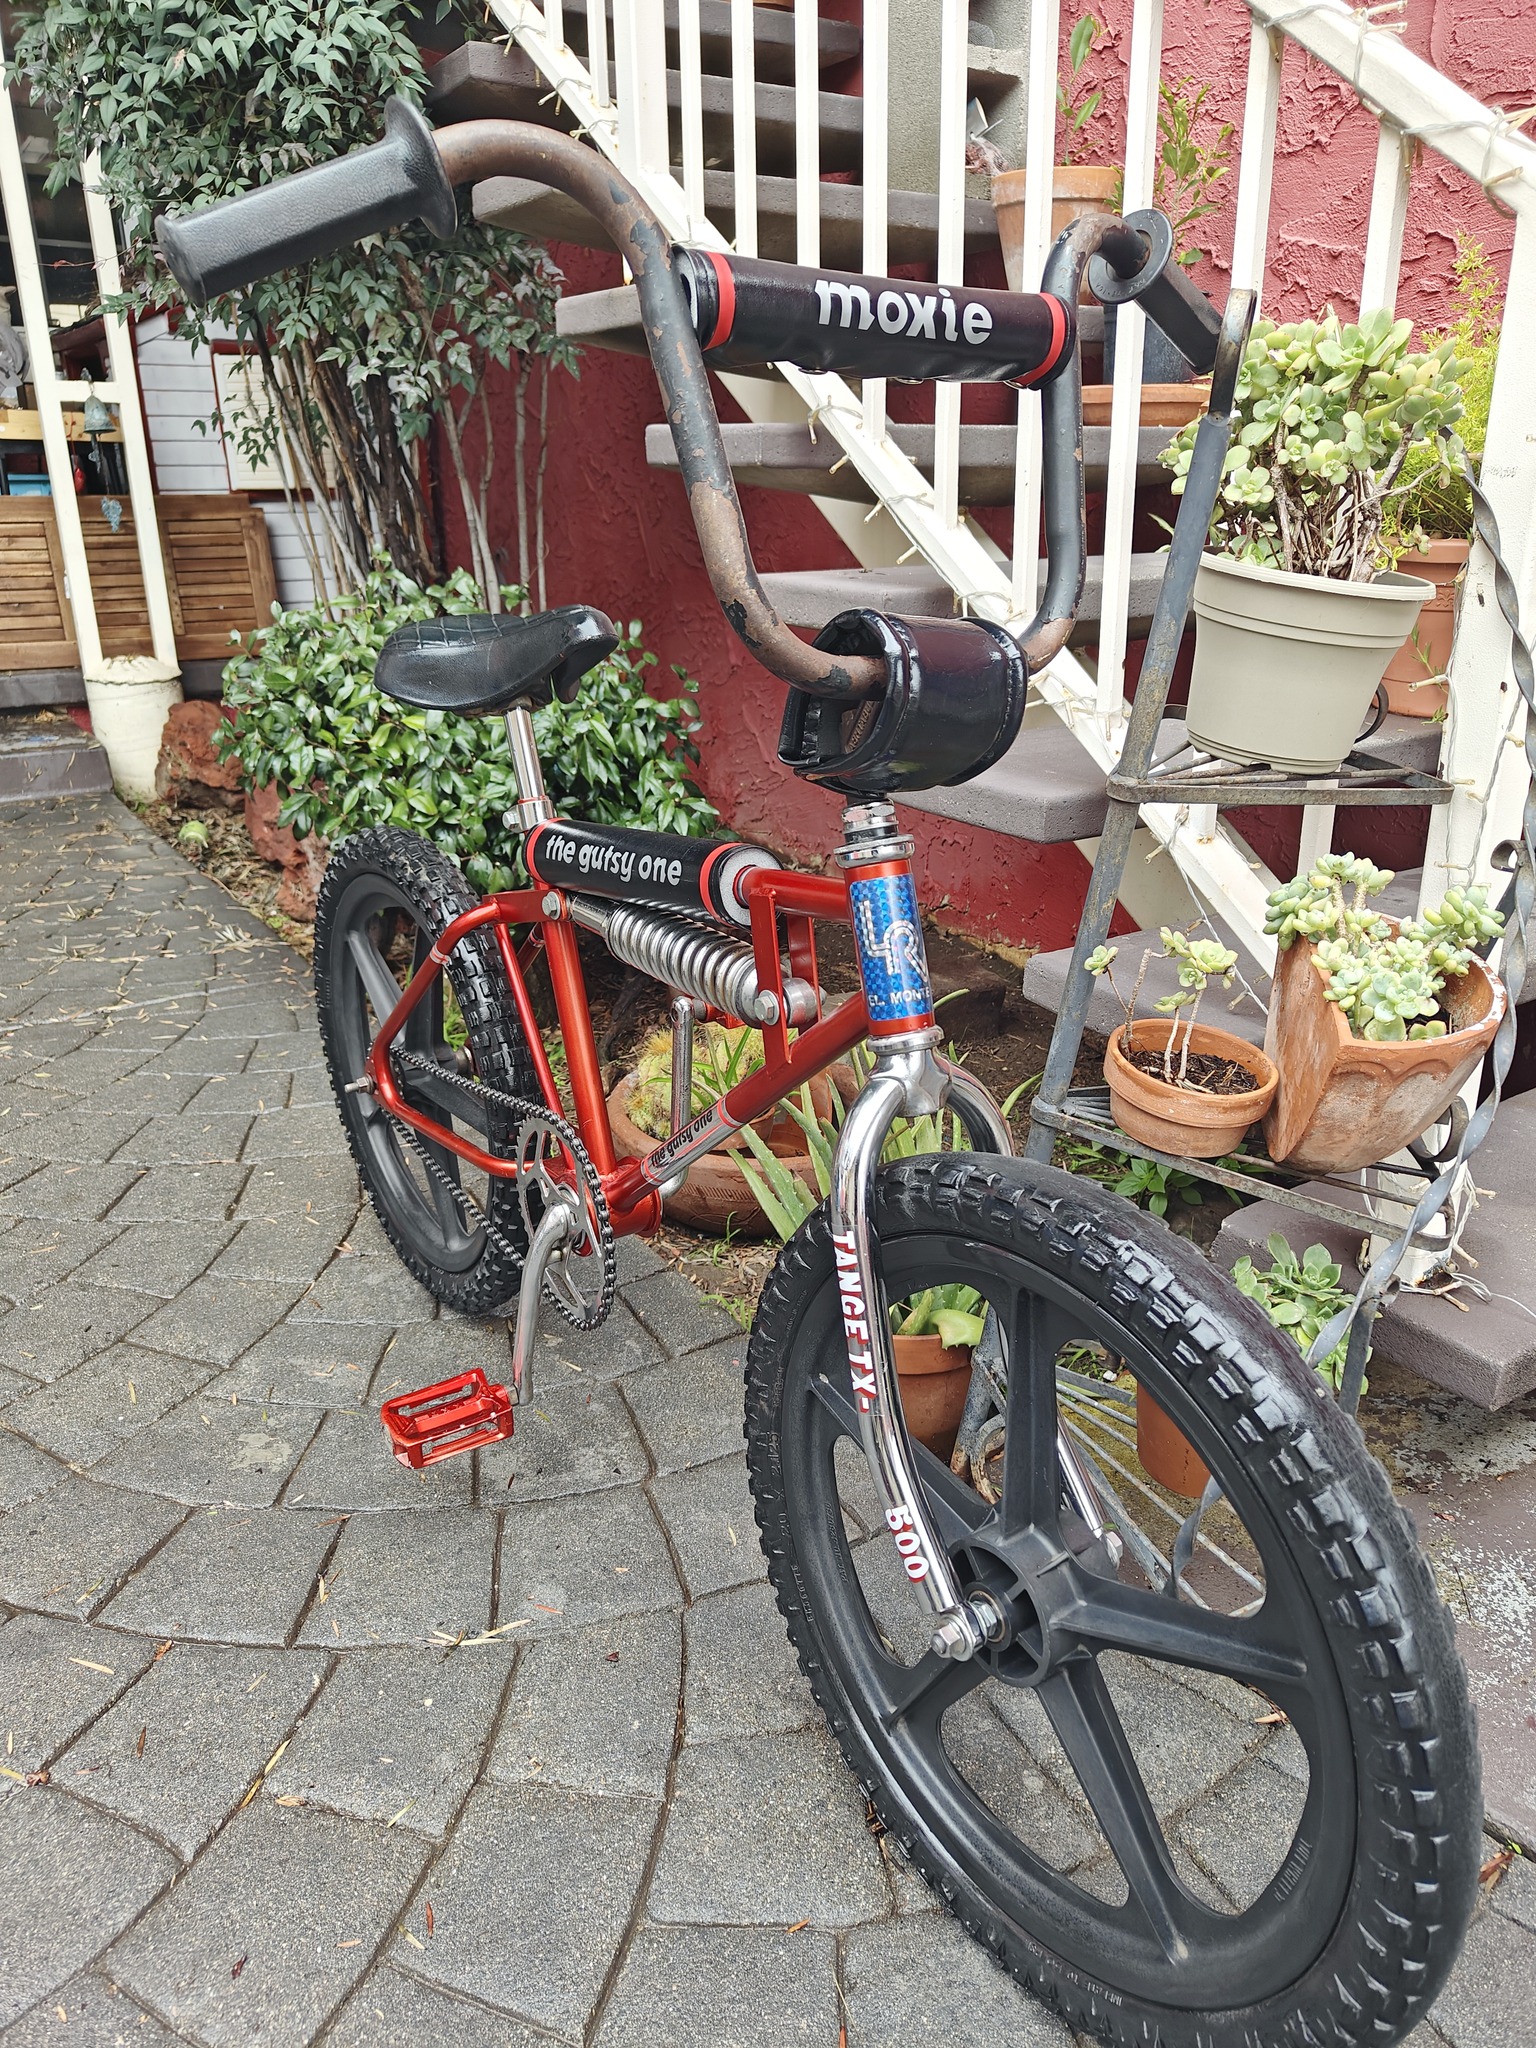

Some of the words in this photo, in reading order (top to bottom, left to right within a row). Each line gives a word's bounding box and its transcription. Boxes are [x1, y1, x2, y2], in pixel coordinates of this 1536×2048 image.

[814, 279, 993, 345] moxie
[545, 834, 576, 864] the
[578, 843, 636, 883] gutsy
[638, 855, 682, 886] one
[889, 986, 930, 1006] MONTE
[650, 1148, 666, 1167] the
[667, 1129, 694, 1158] gutsy
[694, 1109, 713, 1133] one
[832, 1230, 870, 1345] TANGE
[885, 1504, 930, 1584] 500
